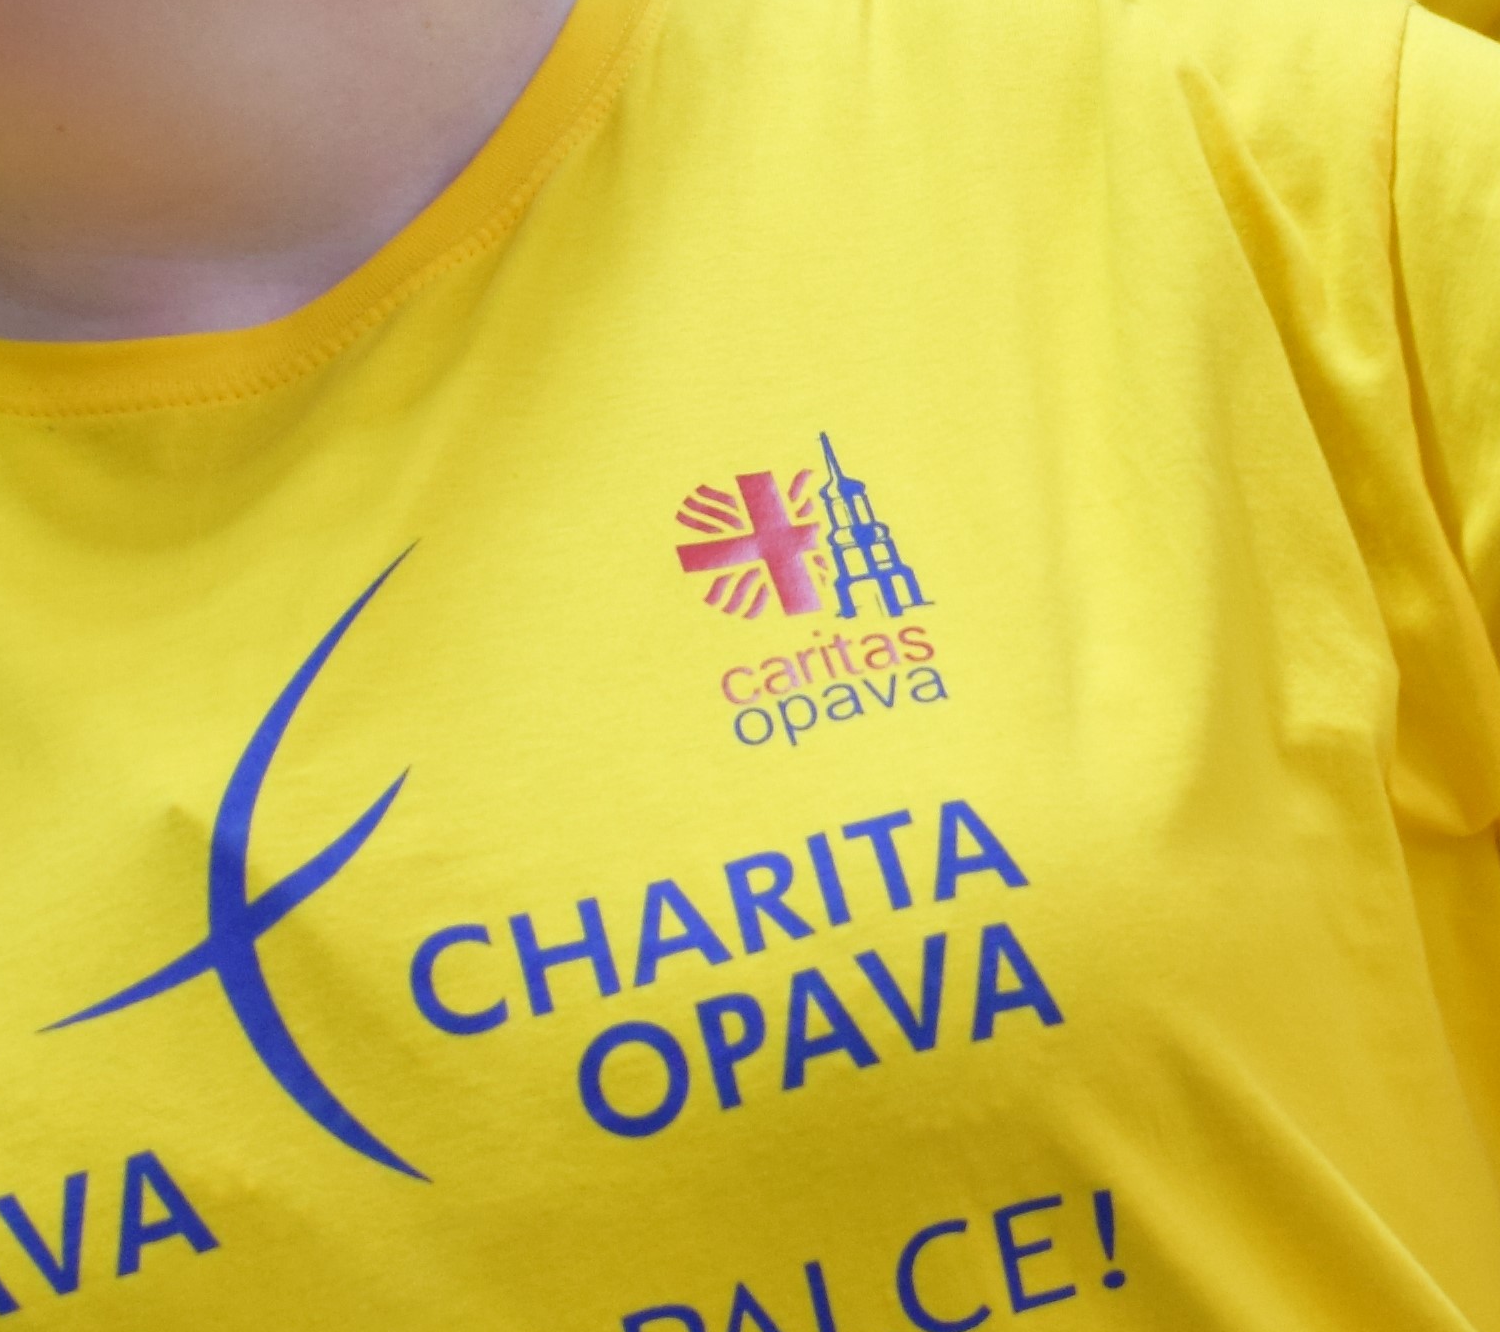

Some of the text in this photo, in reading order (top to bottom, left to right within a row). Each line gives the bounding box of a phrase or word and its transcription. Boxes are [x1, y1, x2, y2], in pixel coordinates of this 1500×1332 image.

[721, 625, 936, 705] caritas
[733, 665, 950, 747] opava
[409, 798, 1030, 1037] CHARITA
[577, 922, 1065, 1139] OPAVA
